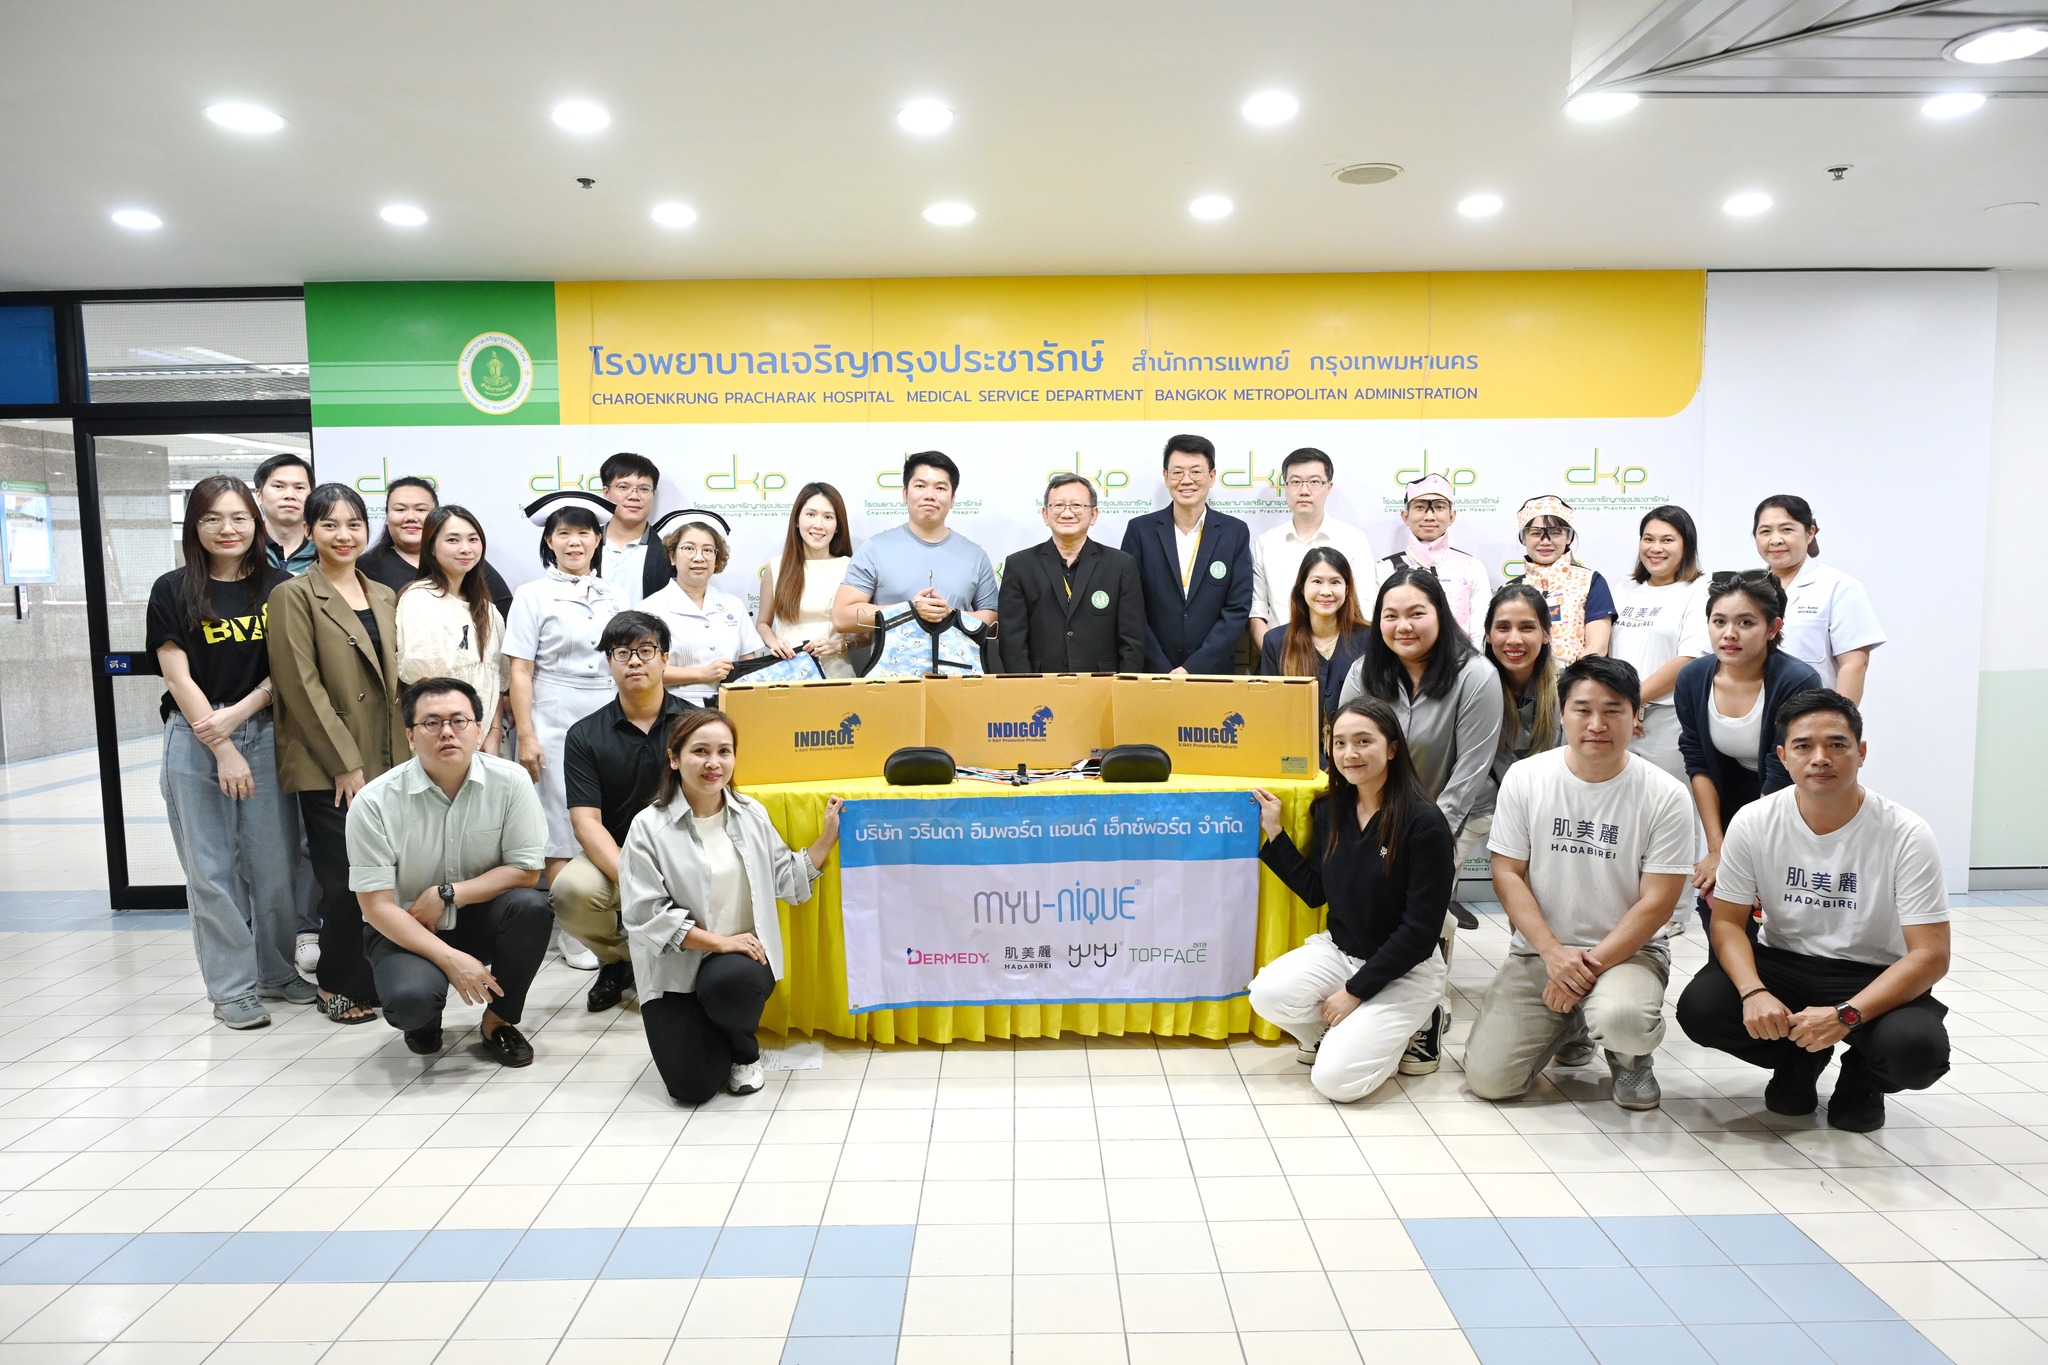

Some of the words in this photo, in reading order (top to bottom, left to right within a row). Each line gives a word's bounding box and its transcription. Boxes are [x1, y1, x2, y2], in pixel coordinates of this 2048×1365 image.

[589, 340, 1105, 383] โรงพยาบาลเจริญกรุงประชารักษ์
[1132, 349, 1290, 372] สำนักการแพทย์
[1310, 352, 1479, 377] กรุงเทพมหานคร
[592, 393, 719, 406] CHAROENKRUNG
[725, 392, 815, 404] PRACHARAK
[823, 391, 895, 403] HOSPITAL
[907, 390, 973, 403] MEDICAL
[979, 389, 1039, 402] SERVICE
[1046, 388, 1143, 402] DEPARTMENT
[1155, 388, 1227, 402] BANGKOK
[1233, 388, 1348, 401] METROPOLITAN
[1354, 387, 1479, 400] ADMINISTRATION
[855, 823, 903, 841] บริษัท
[909, 822, 964, 840] วรินดา
[971, 819, 1042, 839] อิมพอร์ต
[1050, 817, 1097, 837] แอนด์
[1104, 815, 1191, 836] เอ็กซ์พอร์ต
[1198, 816, 1243, 835] จำกัด
[1552, 817, 1619, 845] 肌美麗
[1551, 843, 1617, 860] HADABIREI
[1786, 866, 1858, 893] 肌美麗
[1784, 893, 1857, 910] HADABIREI
[906, 947, 990, 965] DERMEDY
[1004, 944, 1052, 960] 肌美麗
[1004, 962, 1052, 970] HADABIREI
